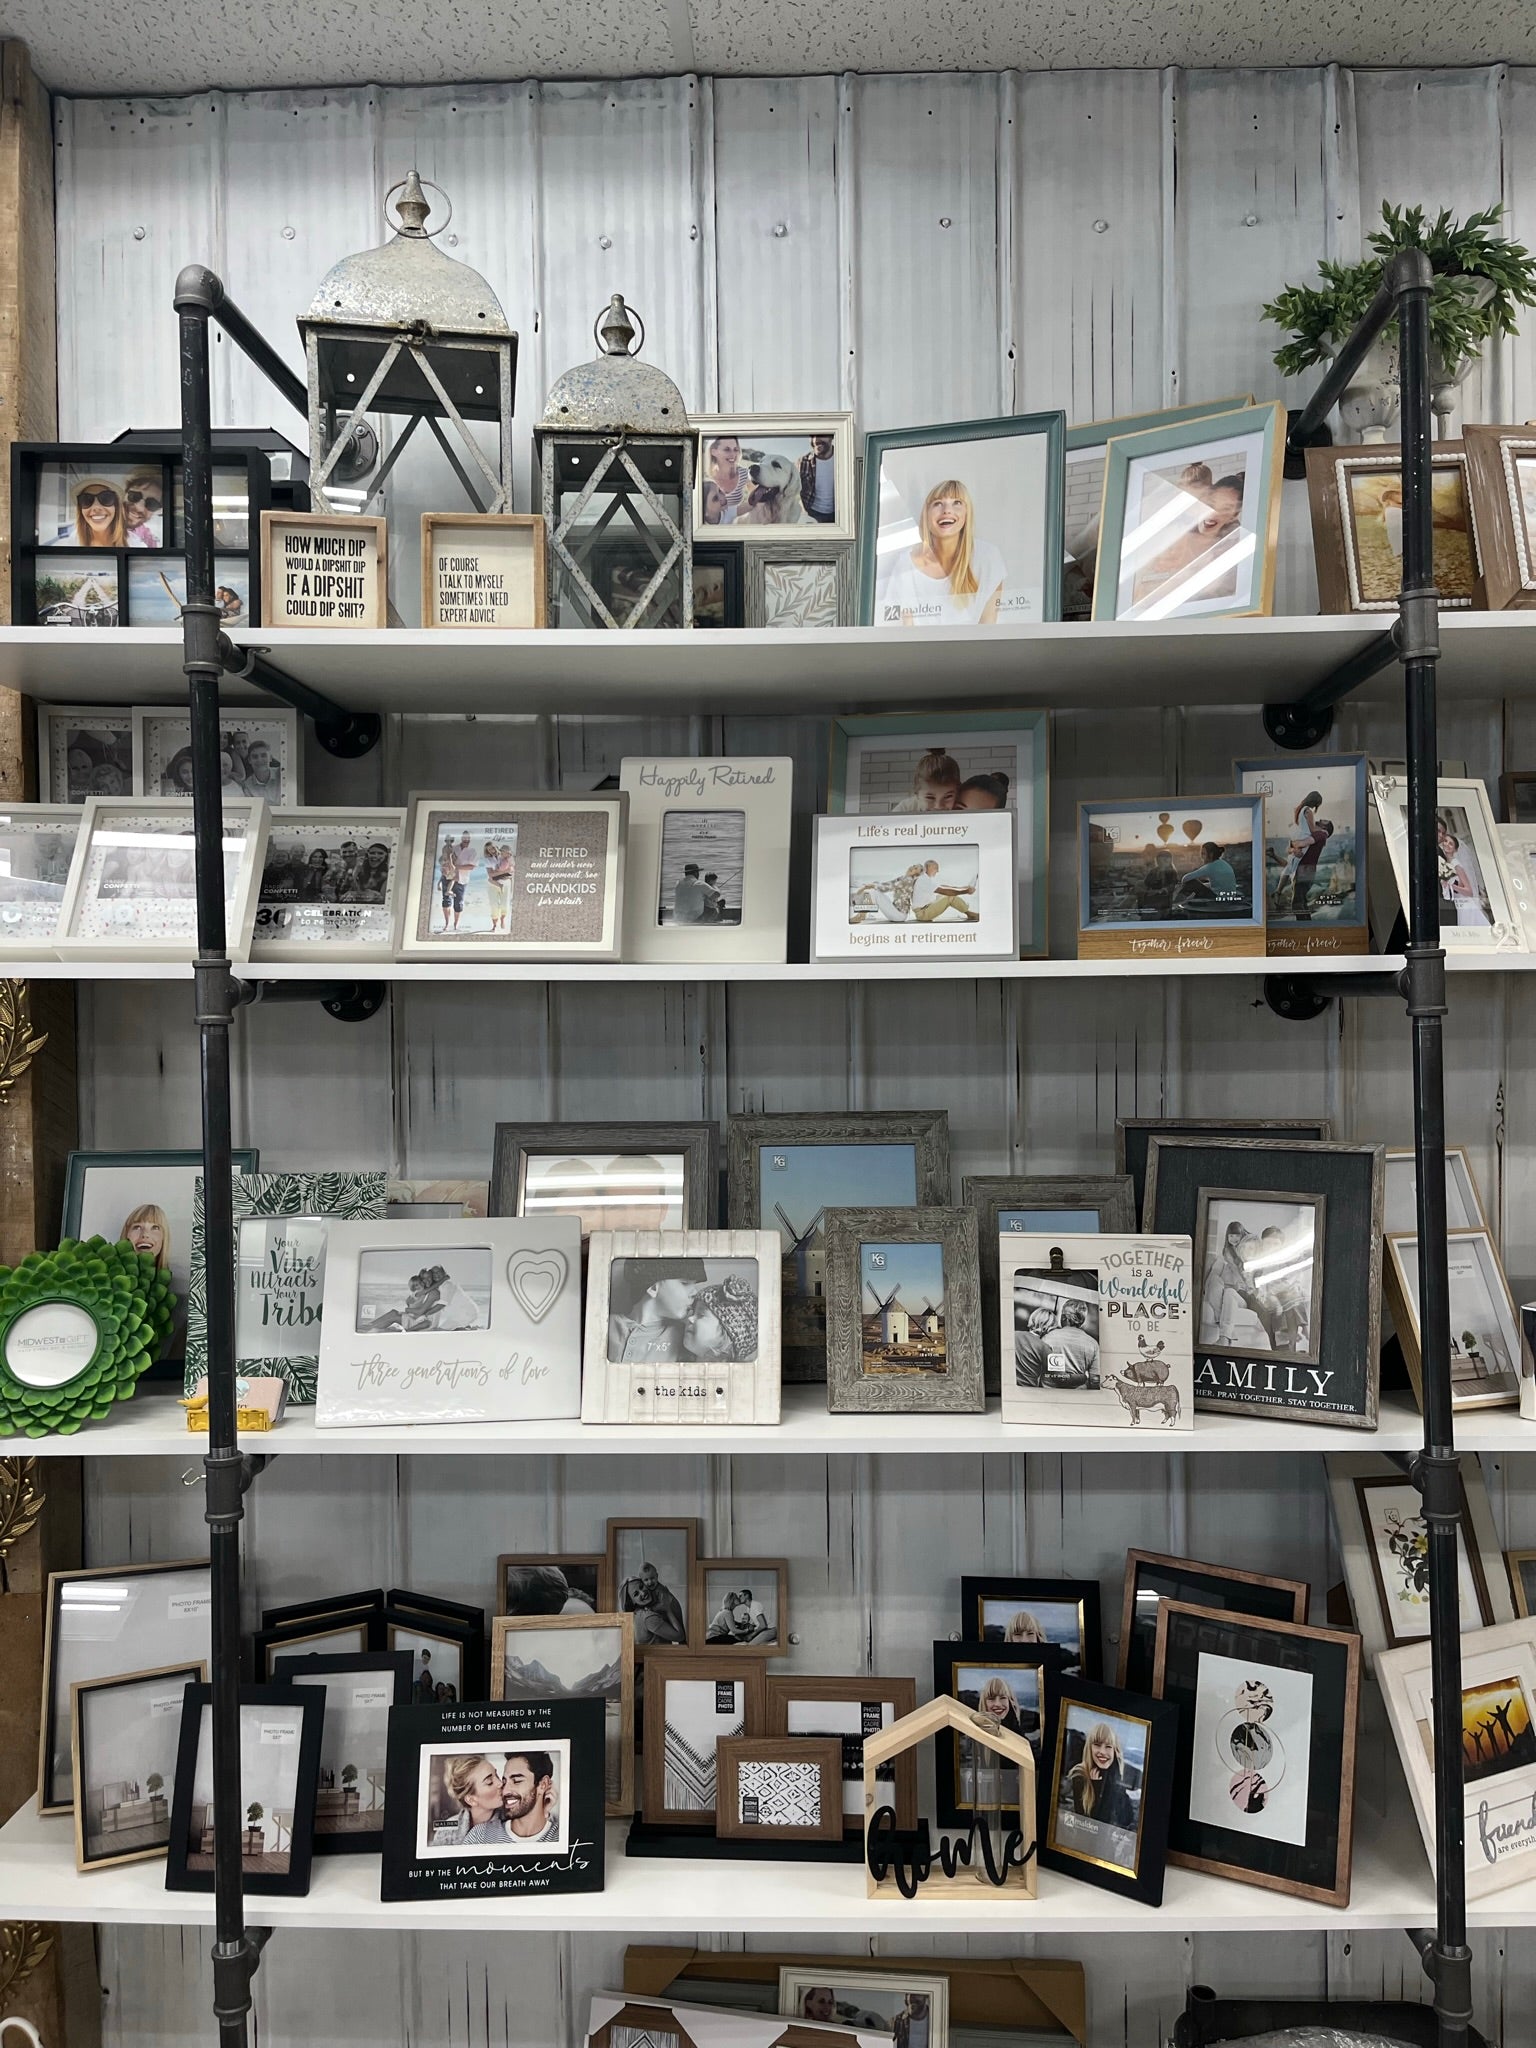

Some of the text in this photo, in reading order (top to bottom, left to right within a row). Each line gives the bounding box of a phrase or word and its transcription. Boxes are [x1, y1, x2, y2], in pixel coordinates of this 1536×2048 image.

[285, 535, 366, 557] HOW MUCH DIP
[286, 557, 366, 573] WOULD A DIPSHIT DIP
[439, 557, 479, 572] OF COURSE
[286, 573, 365, 599] IF A DIPSHIT
[444, 574, 463, 589] TALK
[464, 574, 474, 589] TO
[475, 574, 504, 589] MYSELF
[439, 591, 483, 606] SOMETIMES
[489, 592, 509, 606] NEED
[286, 600, 365, 619] COULD DIP SHIT?
[440, 608, 496, 623] EXPERT ADVICE
[902, 603, 942, 617] malden
[639, 765, 776, 797] Happily Retired
[858, 824, 969, 839] Life's real journey
[539, 847, 588, 858] RETIRED
[531, 860, 548, 869] and
[550, 860, 576, 869] under
[526, 883, 597, 894] GRANDKIDS
[538, 896, 583, 906] for details
[303, 909, 372, 918] CELEBRATION
[850, 932, 977, 947] begins at retirement
[1129, 936, 1214, 953] together forever
[1267, 938, 1300, 951] ogether
[274, 1236, 302, 1250] Your
[270, 1248, 320, 1274] Vibe
[1101, 1250, 1184, 1273] TOGETHER
[1131, 1267, 1154, 1277] is a
[274, 1288, 298, 1300] Your
[1099, 1277, 1188, 1305] Wonderful
[1107, 1302, 1180, 1320] PLACE
[1128, 1320, 1160, 1332] TO BE
[18, 1336, 60, 1347] MIDWEST
[350, 1352, 551, 1390] three generations of love
[1194, 1358, 1335, 1397] AMILY
[654, 1385, 707, 1397] the kids
[1217, 1390, 1238, 1400] PRAY
[1240, 1393, 1285, 1404] TOGETHER.
[1287, 1398, 1308, 1407] STAY
[1309, 1400, 1357, 1412] TOGETHER.
[441, 1712, 456, 1720] LIFE
[459, 1711, 466, 1719] IS
[486, 1709, 525, 1718] MEASURED
[441, 1724, 471, 1732] NUMBER
[487, 1722, 518, 1731] BREATHS
[534, 1721, 551, 1729] TAKE
[1498, 1835, 1536, 1854] are everyth
[408, 1870, 422, 1878] BUT
[438, 1869, 451, 1877] THE
[456, 1838, 595, 1875] moments
[868, 1806, 1036, 1899] home
[440, 1878, 550, 1890] THAT TAKE OUR BREATH AWAY
